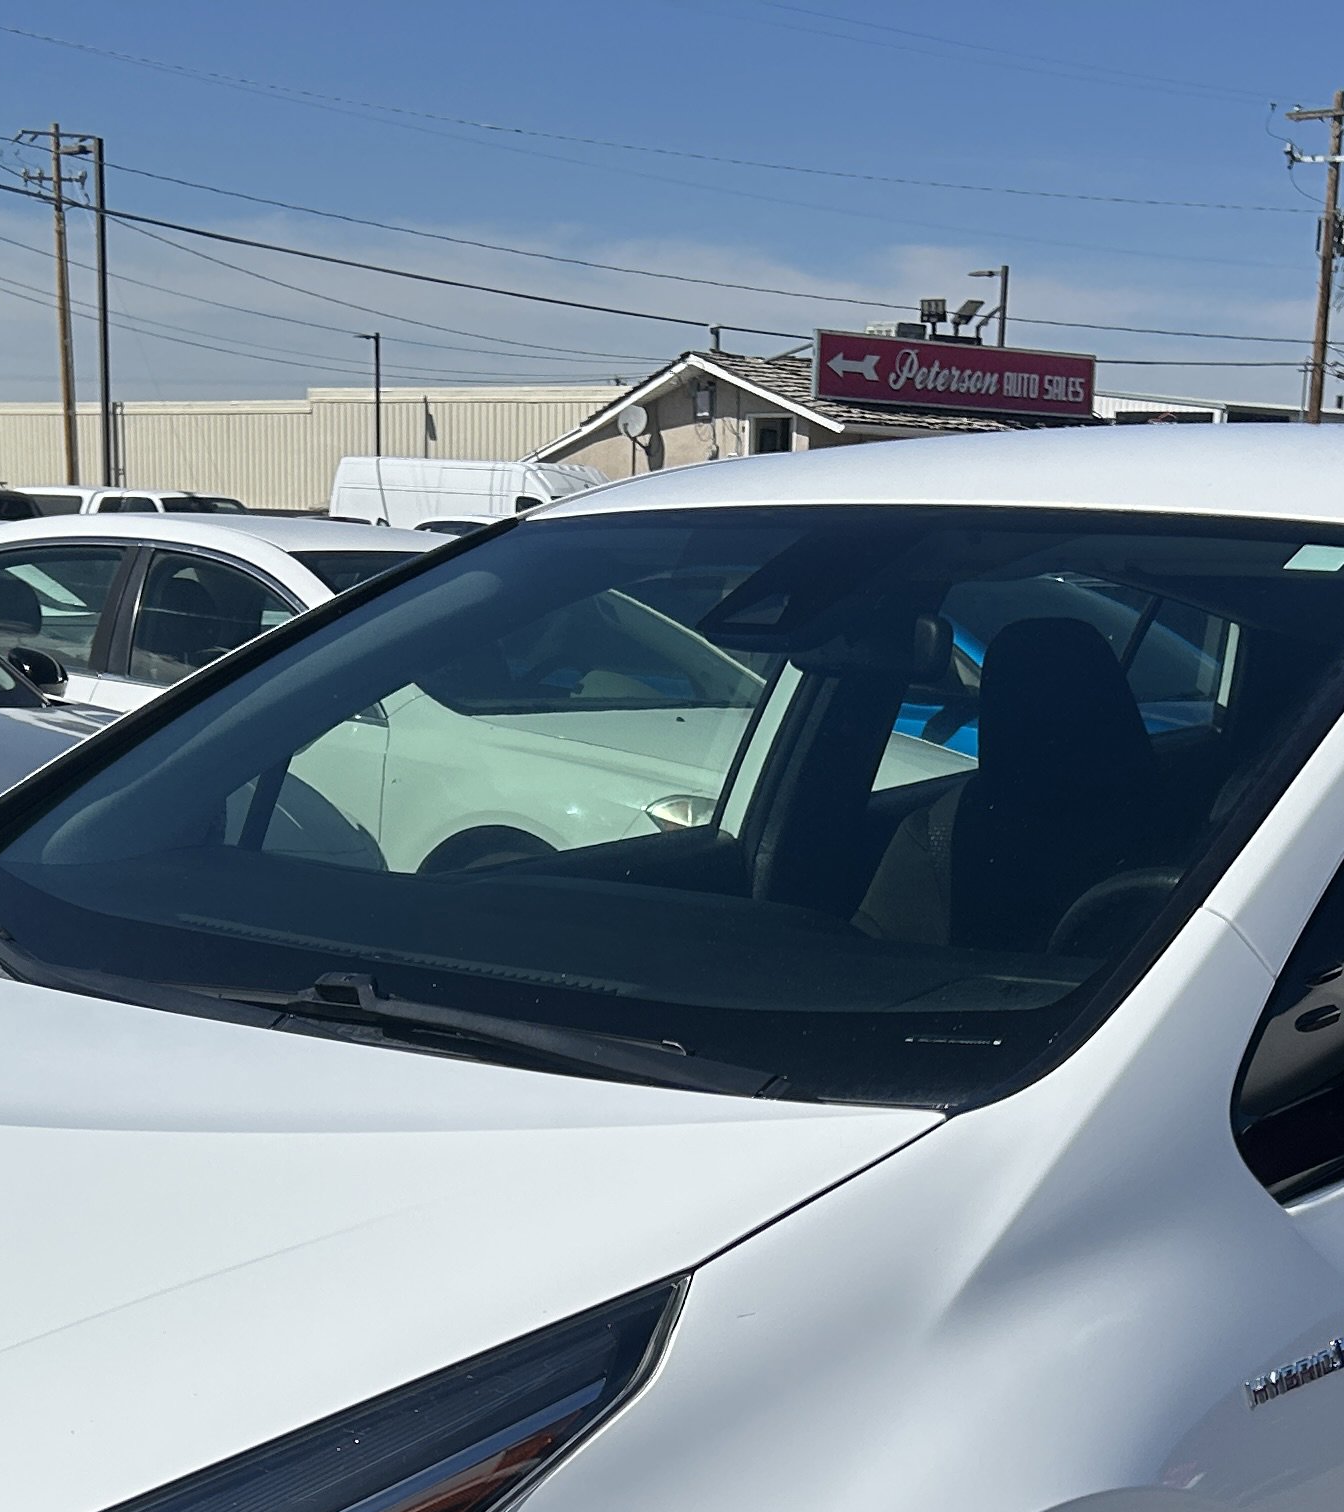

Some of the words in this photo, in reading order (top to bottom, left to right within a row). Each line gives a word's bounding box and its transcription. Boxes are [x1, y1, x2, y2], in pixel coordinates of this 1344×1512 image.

[888, 349, 1000, 395] Peterson
[1002, 374, 1039, 398] AUTO
[1043, 374, 1086, 403] SALES
